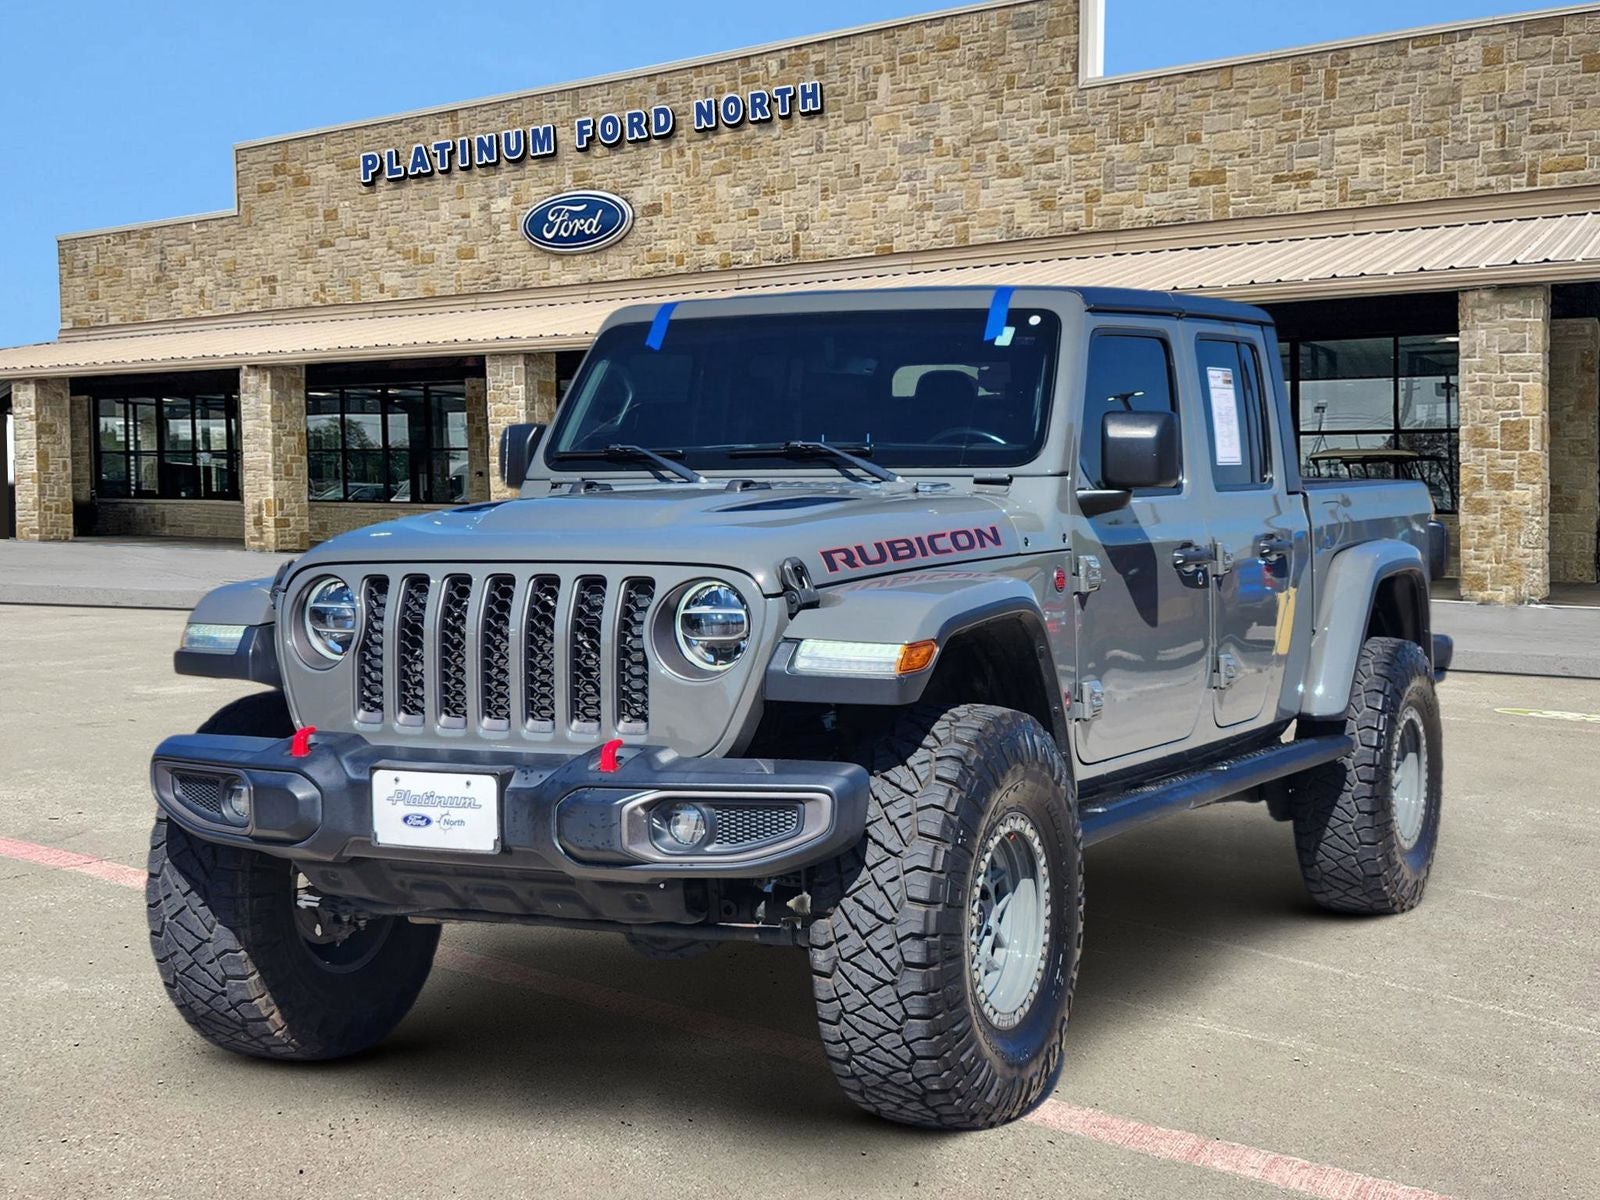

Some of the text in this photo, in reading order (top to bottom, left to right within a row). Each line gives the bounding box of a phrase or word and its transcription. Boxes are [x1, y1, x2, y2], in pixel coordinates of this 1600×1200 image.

[359, 81, 824, 186] PLATINUM FORD NORTH
[542, 204, 602, 239] Ford
[819, 526, 1002, 575] RUBICON
[386, 789, 482, 809] Platinum
[406, 814, 465, 827] Ford North
